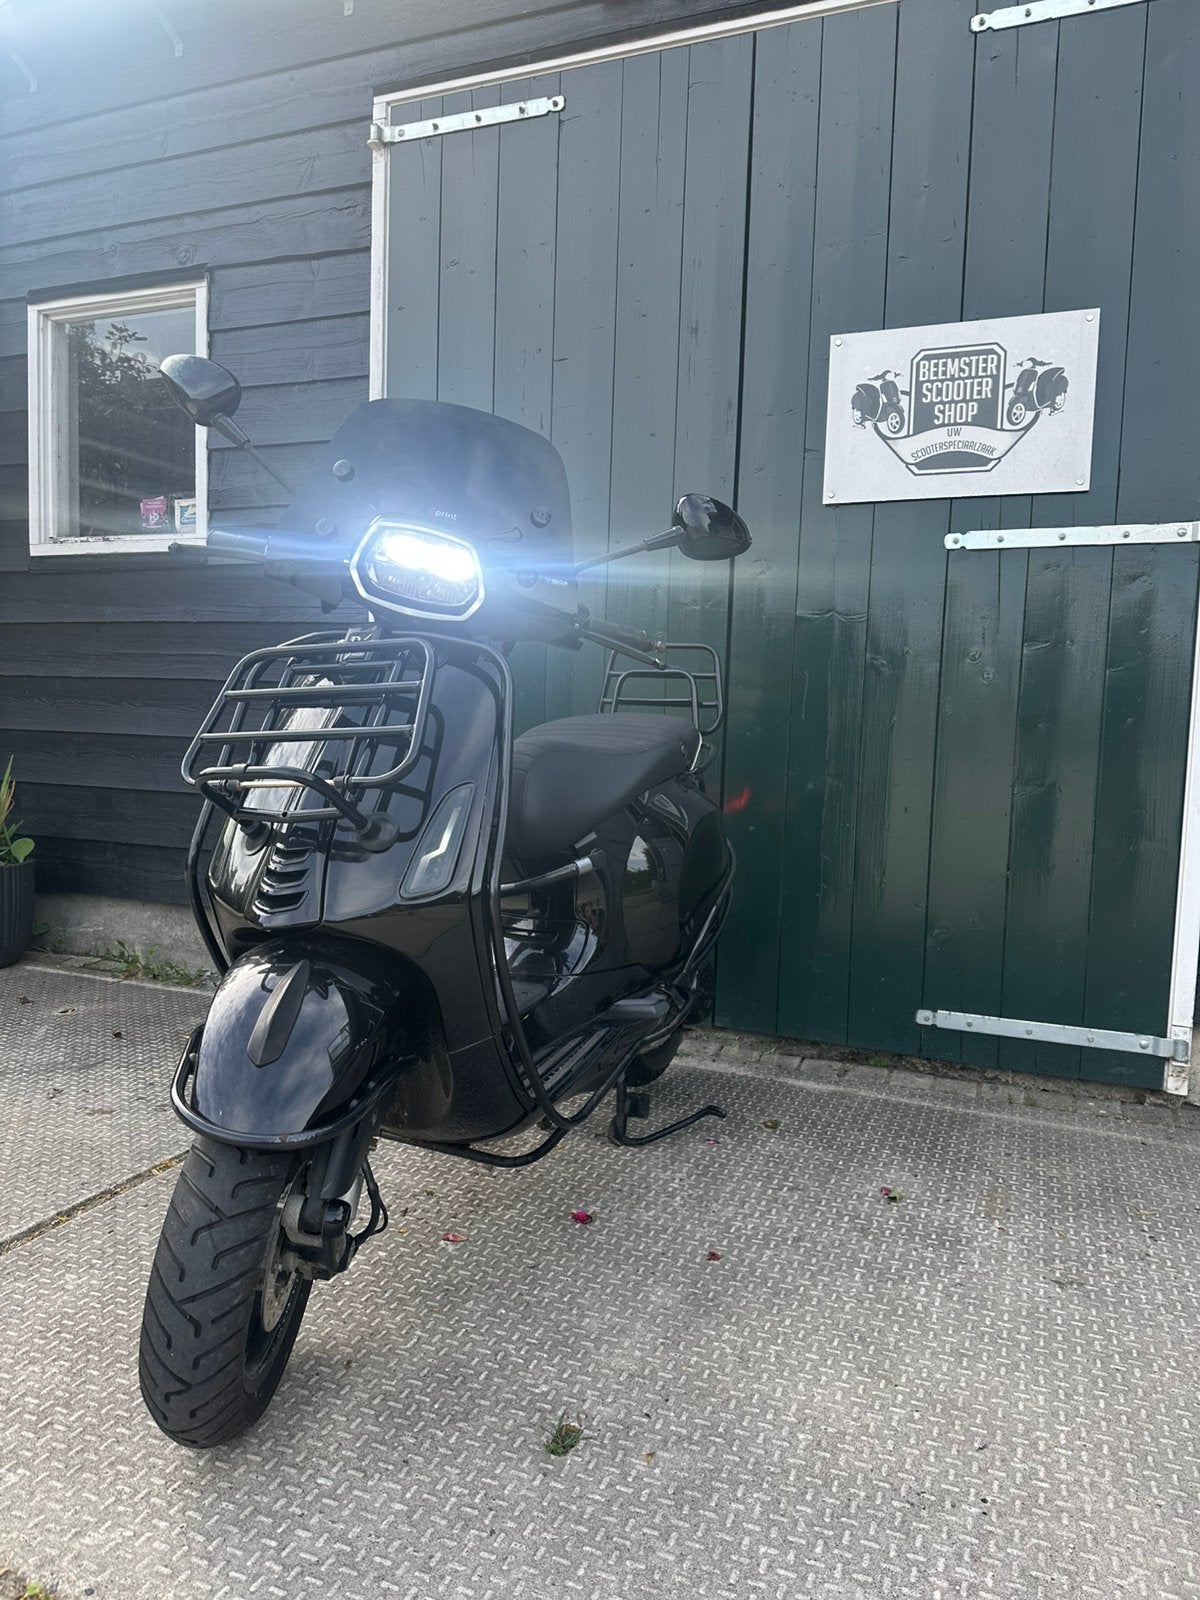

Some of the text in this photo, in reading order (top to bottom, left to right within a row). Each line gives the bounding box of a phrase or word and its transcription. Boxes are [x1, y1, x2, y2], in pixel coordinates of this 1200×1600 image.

[920, 354, 997, 381] BEEMSTER
[922, 378, 992, 403] SCOOTER
[934, 402, 978, 425] SHOP
[947, 428, 962, 437] UW
[911, 440, 997, 461] SCOOTERSPECIAALZAAK
